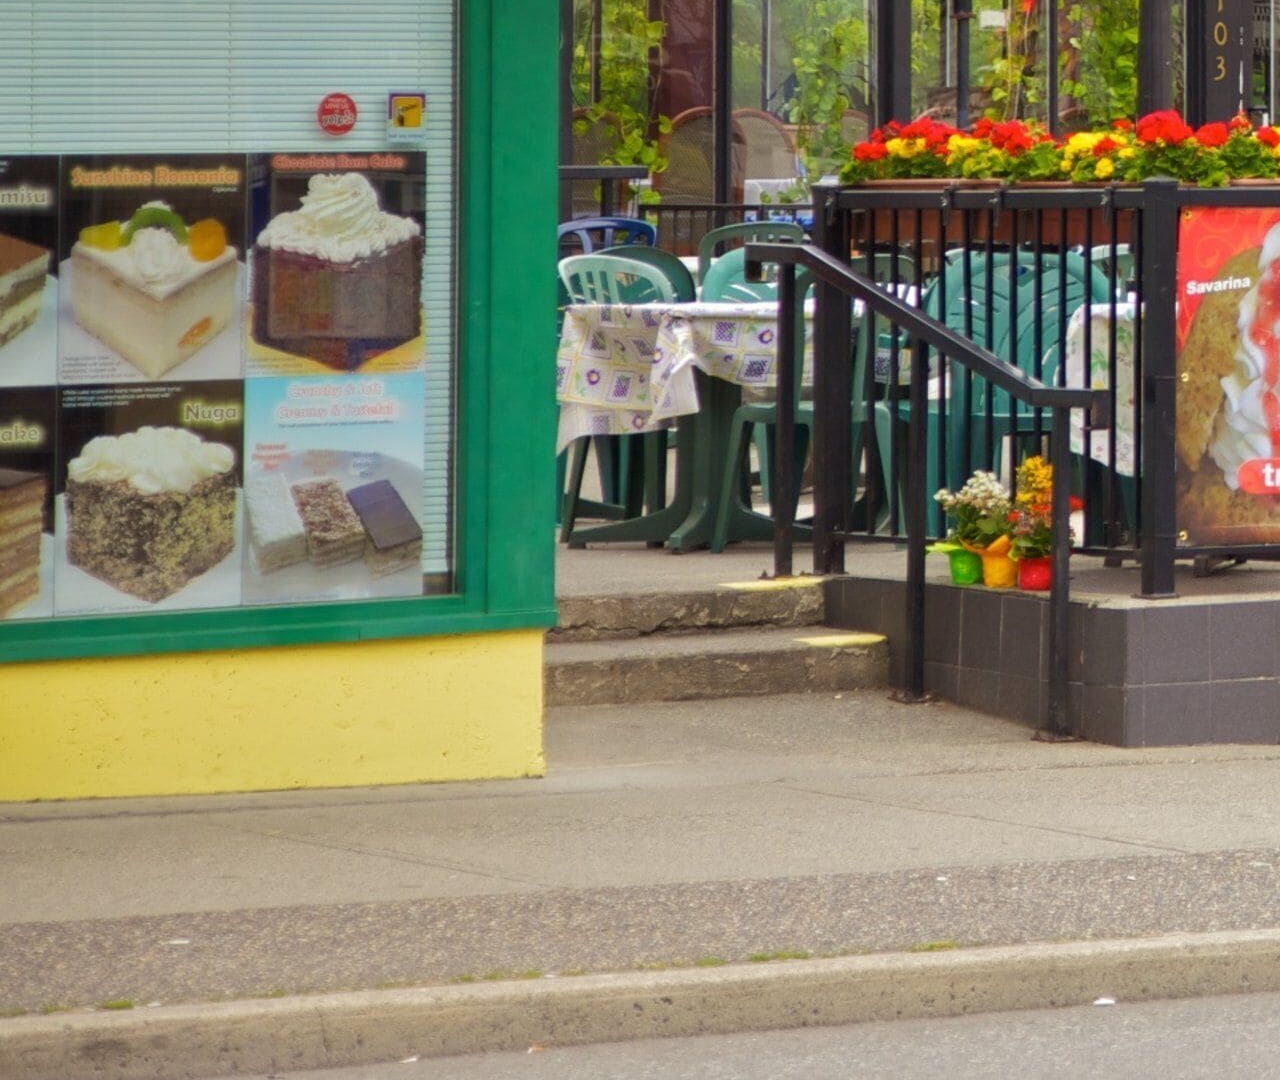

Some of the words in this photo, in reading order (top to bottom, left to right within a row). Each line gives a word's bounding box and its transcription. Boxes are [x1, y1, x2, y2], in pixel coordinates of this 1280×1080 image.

[155, 165, 238, 184] Romania
[1186, 276, 1251, 295] Savarina
[186, 404, 237, 420] Nuga
